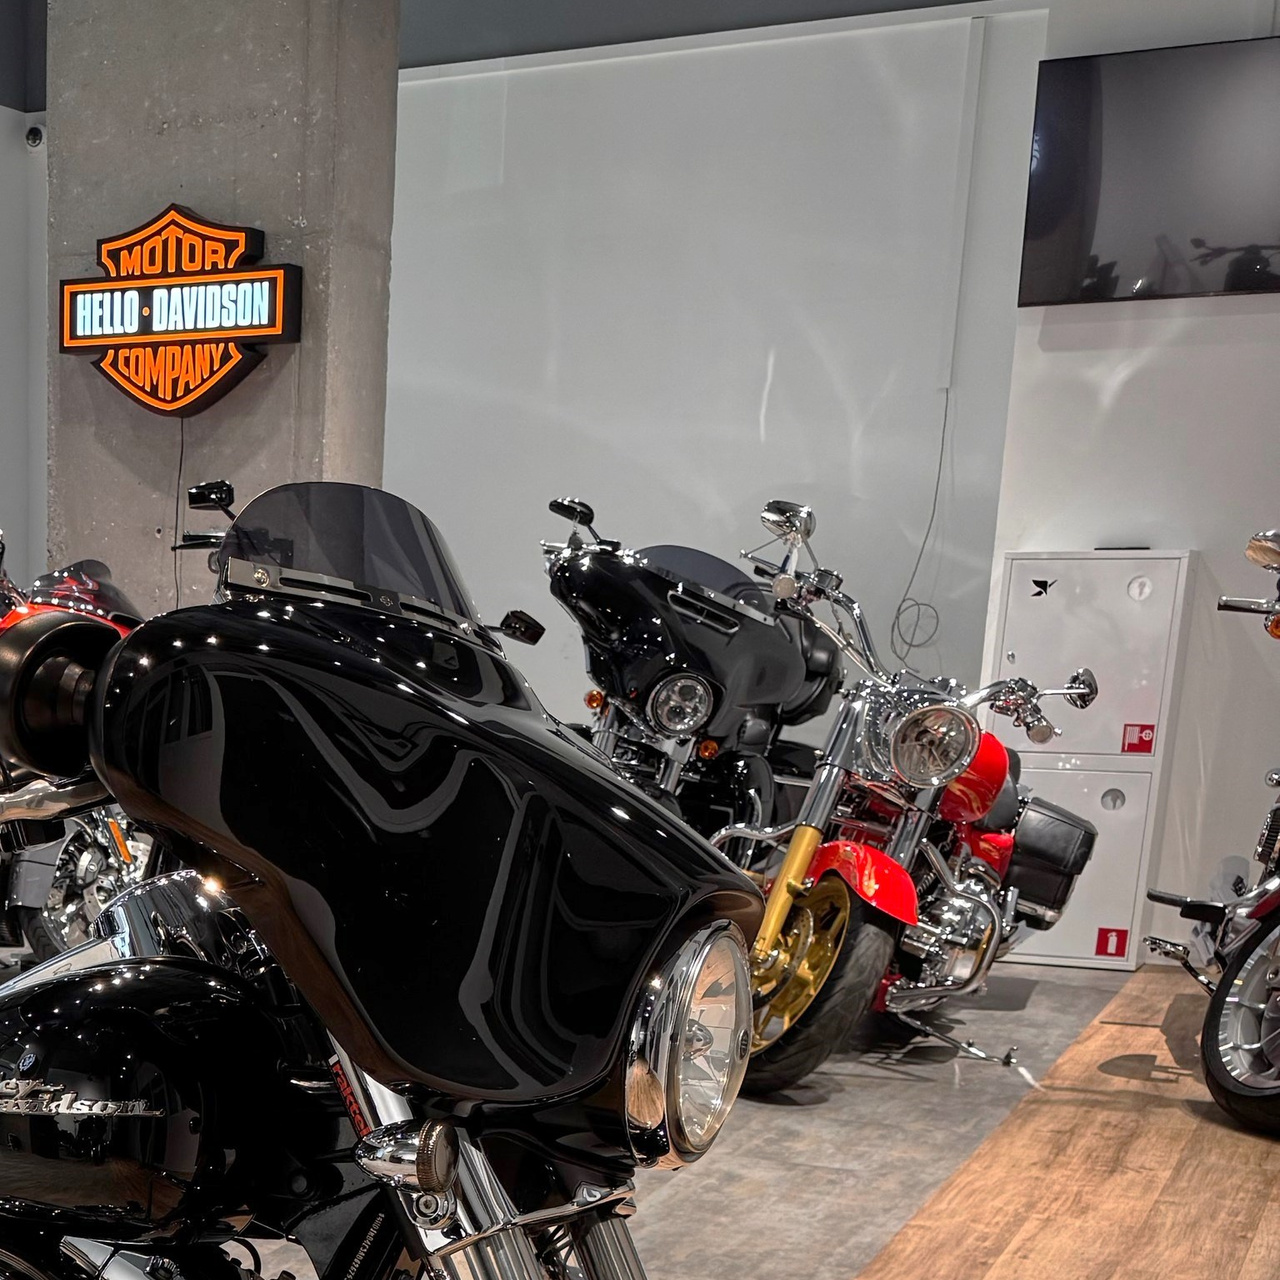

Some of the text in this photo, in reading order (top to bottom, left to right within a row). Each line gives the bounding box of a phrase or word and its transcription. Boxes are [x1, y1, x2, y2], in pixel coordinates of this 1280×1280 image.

[120, 224, 226, 277] MOTOR
[76, 281, 270, 336] HELLO DAVIDSON
[118, 342, 226, 401] COMPANY
